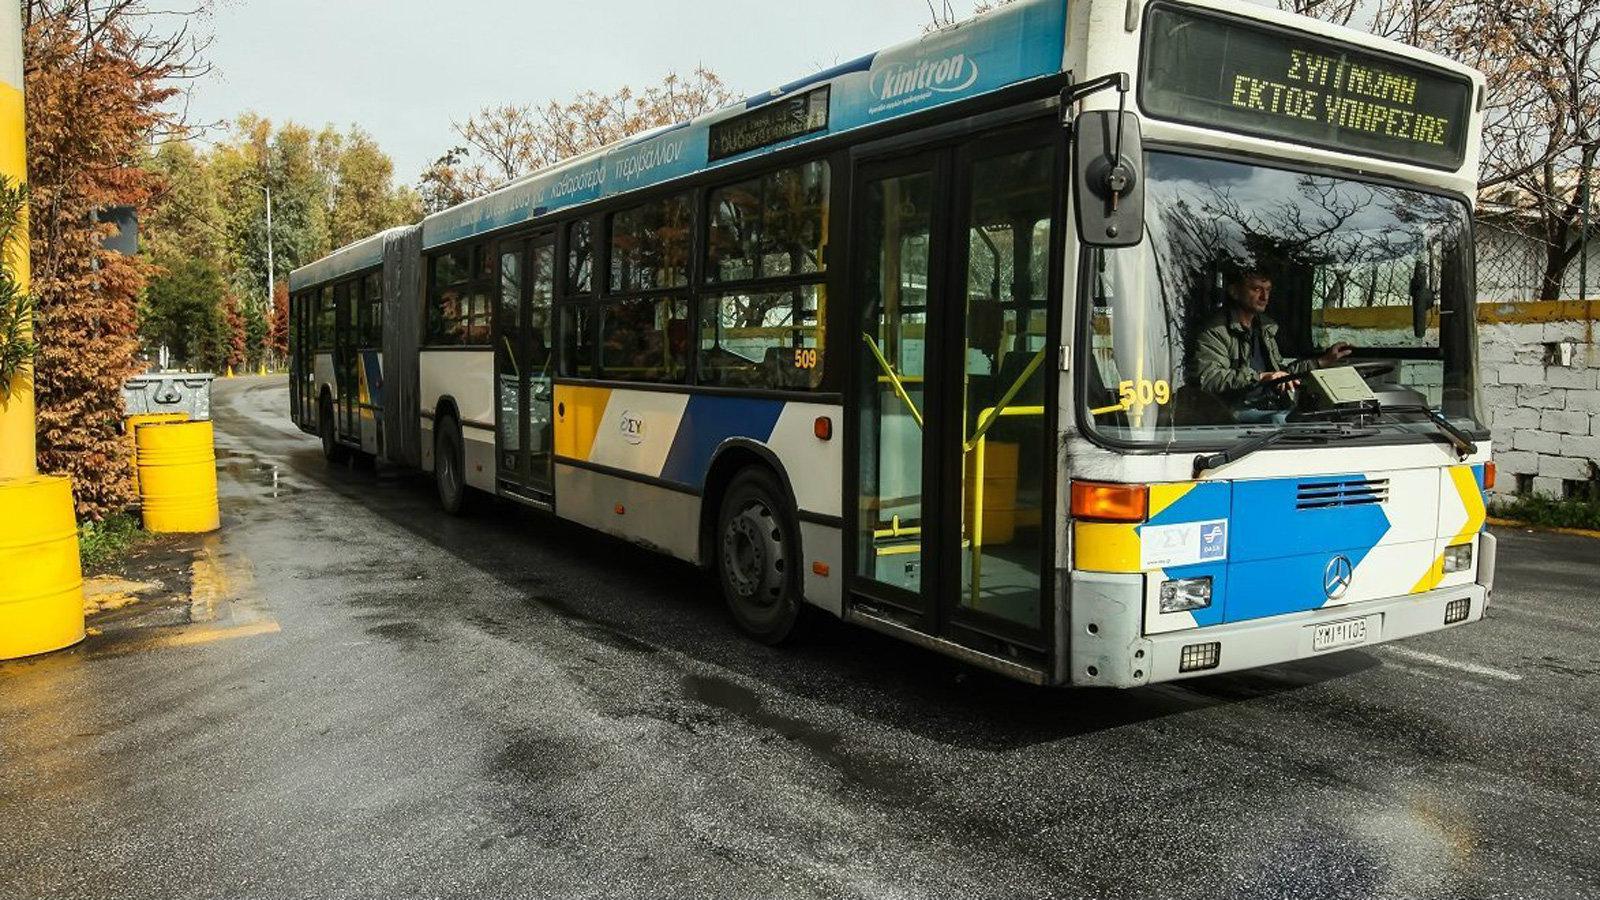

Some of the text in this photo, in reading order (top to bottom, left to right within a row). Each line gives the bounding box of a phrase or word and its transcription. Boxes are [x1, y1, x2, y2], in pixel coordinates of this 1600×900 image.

[881, 53, 965, 100] kinitron
[1232, 75, 1449, 145] ΕΚΤΟΣ ΥΠΗΡΕΣΙΑΣ
[794, 348, 817, 369] 509
[1119, 379, 1170, 405] 509
